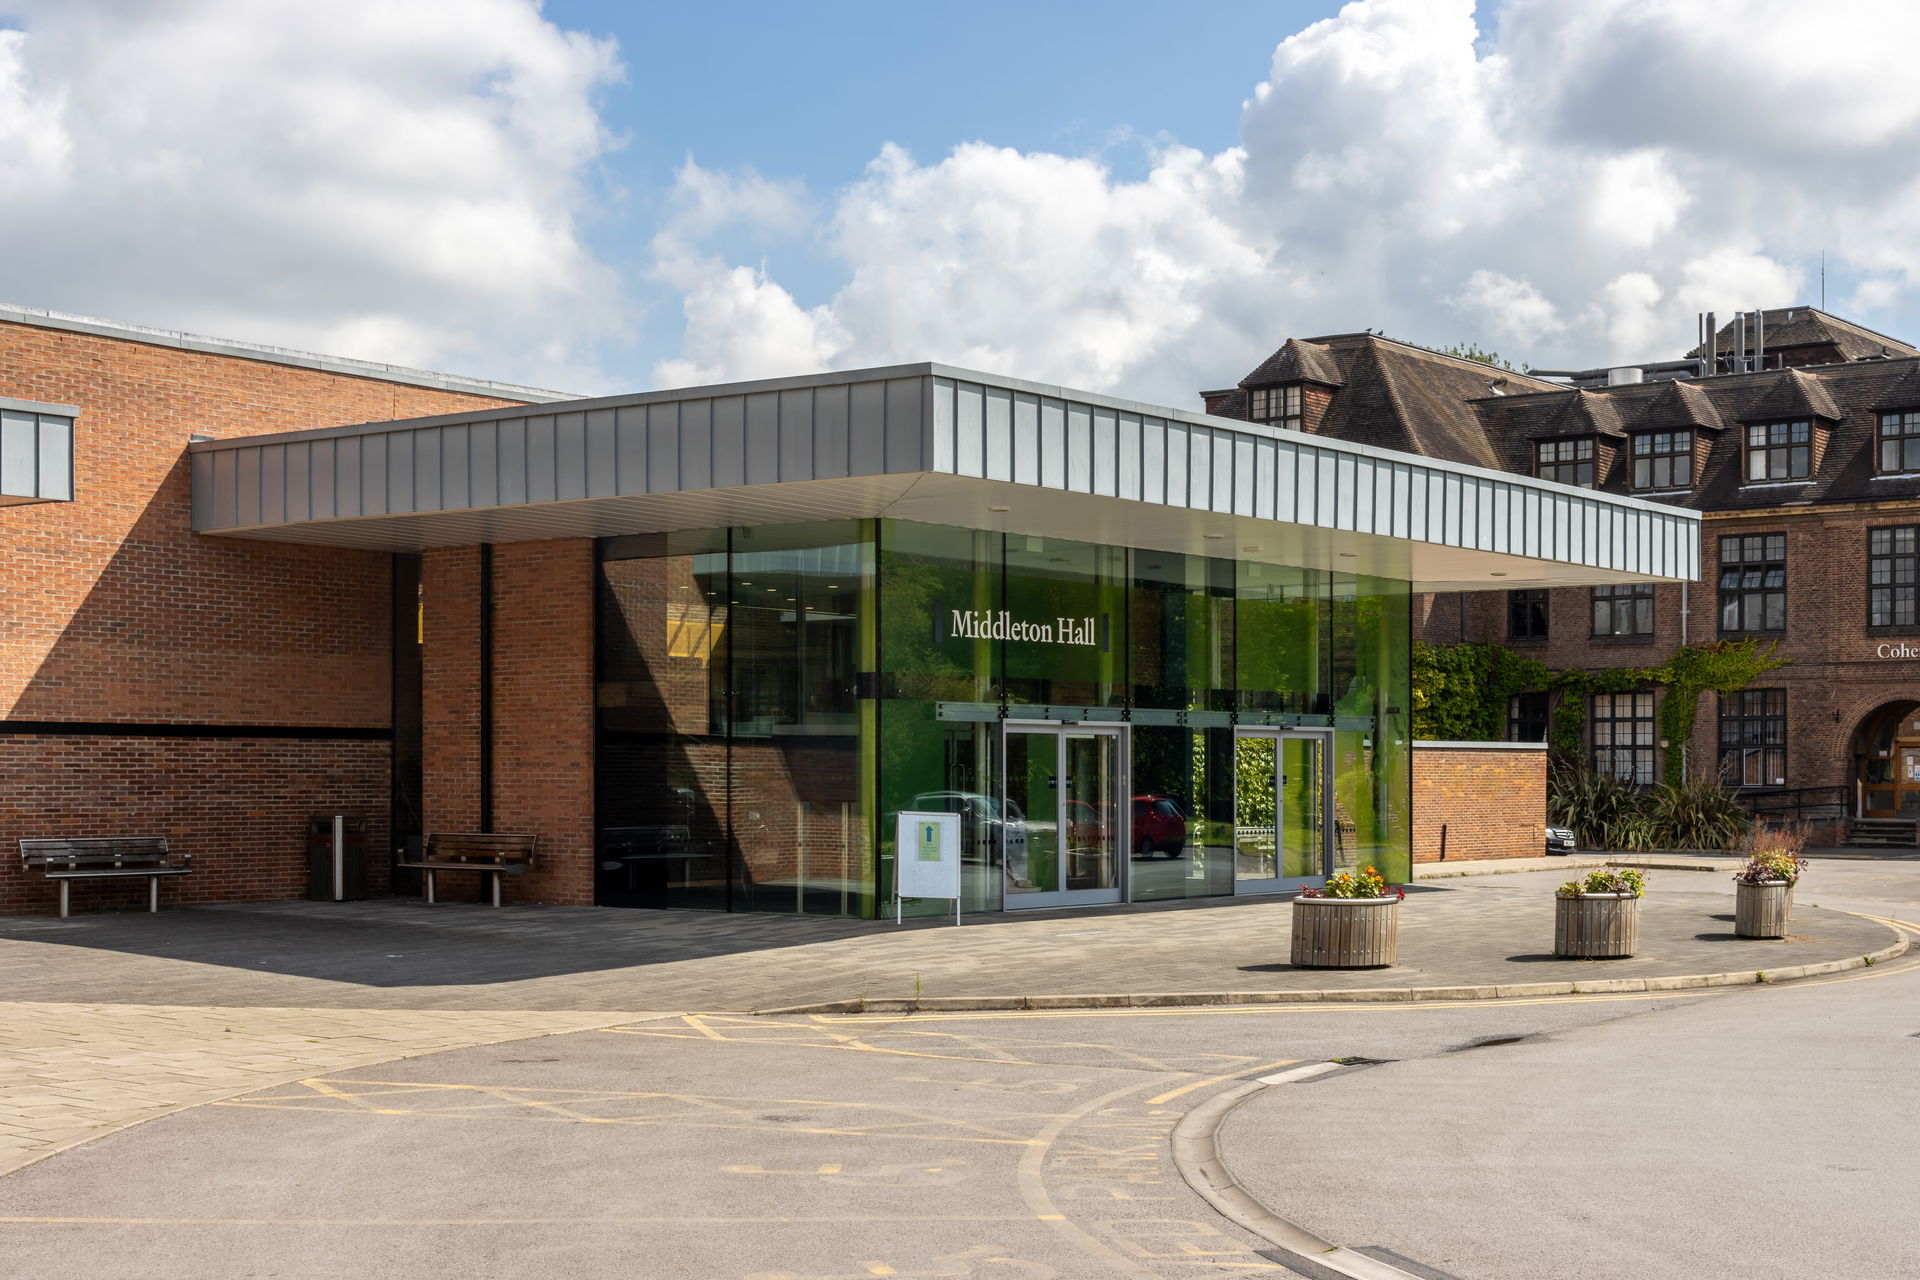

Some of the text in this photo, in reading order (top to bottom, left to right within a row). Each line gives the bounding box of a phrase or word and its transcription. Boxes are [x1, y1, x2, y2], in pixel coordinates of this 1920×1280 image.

[951, 610, 1096, 645] Middleton Hall
[1877, 643, 1920, 659] Cohe
